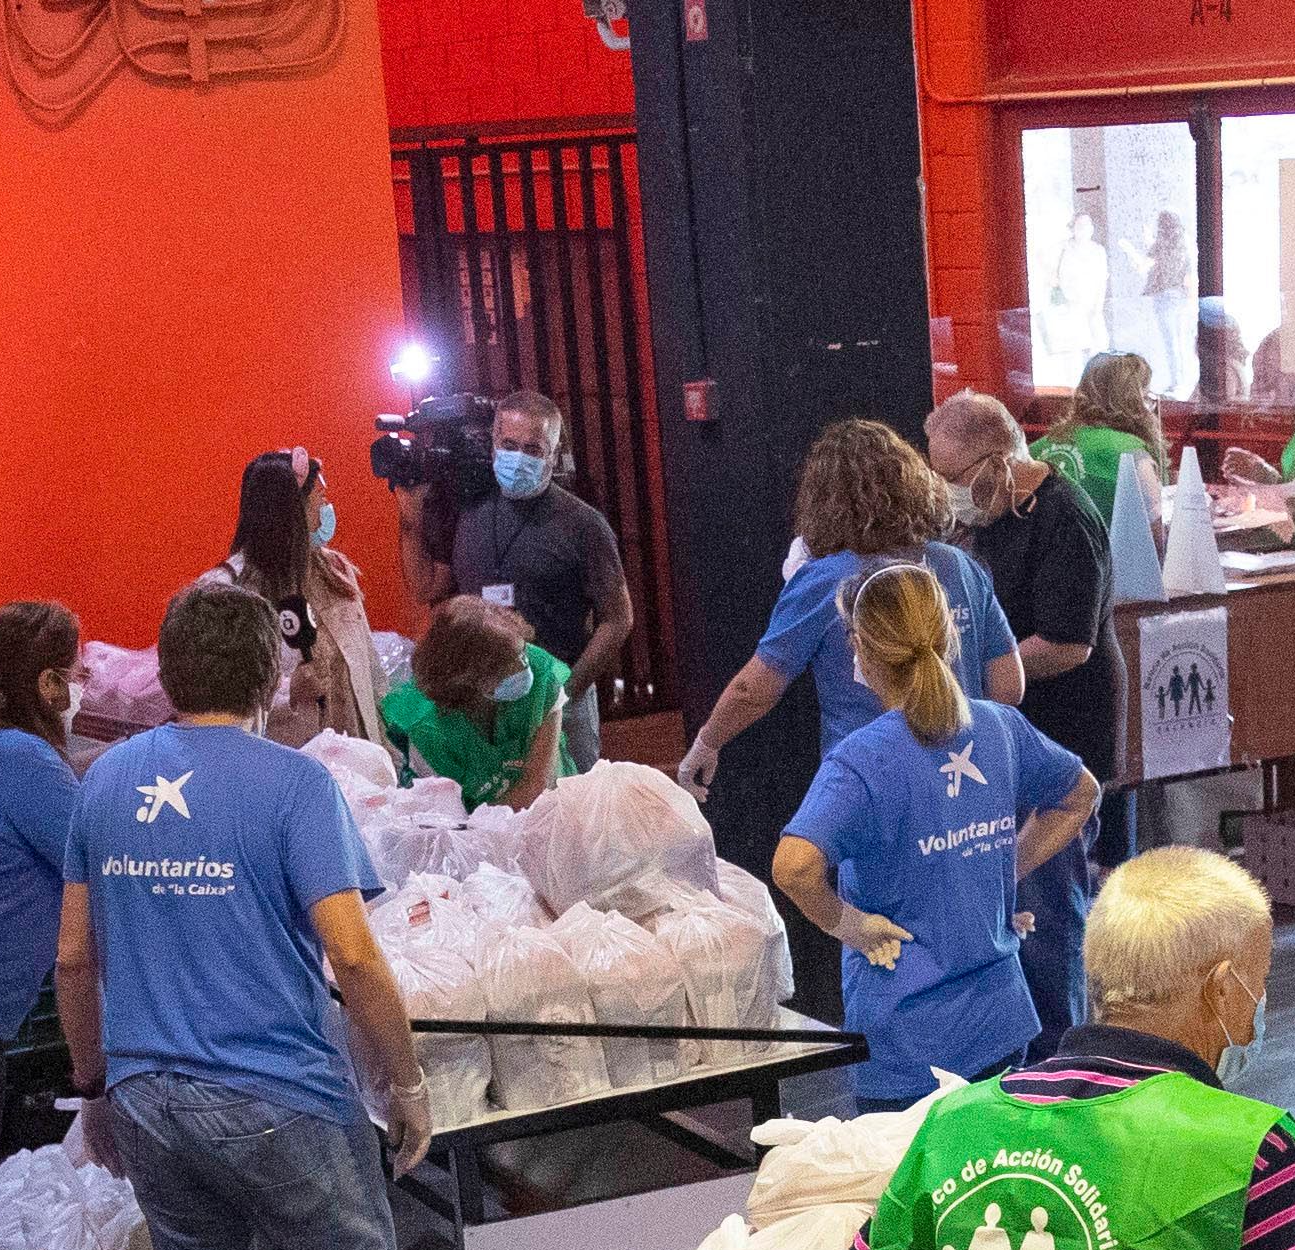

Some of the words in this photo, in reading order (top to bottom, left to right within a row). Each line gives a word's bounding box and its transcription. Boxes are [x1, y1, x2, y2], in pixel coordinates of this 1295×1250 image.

[102, 855, 235, 879] Voluntarios
[152, 884, 165, 895] de
[961, 1158, 987, 1183] de
[992, 1148, 1064, 1176] Acción
